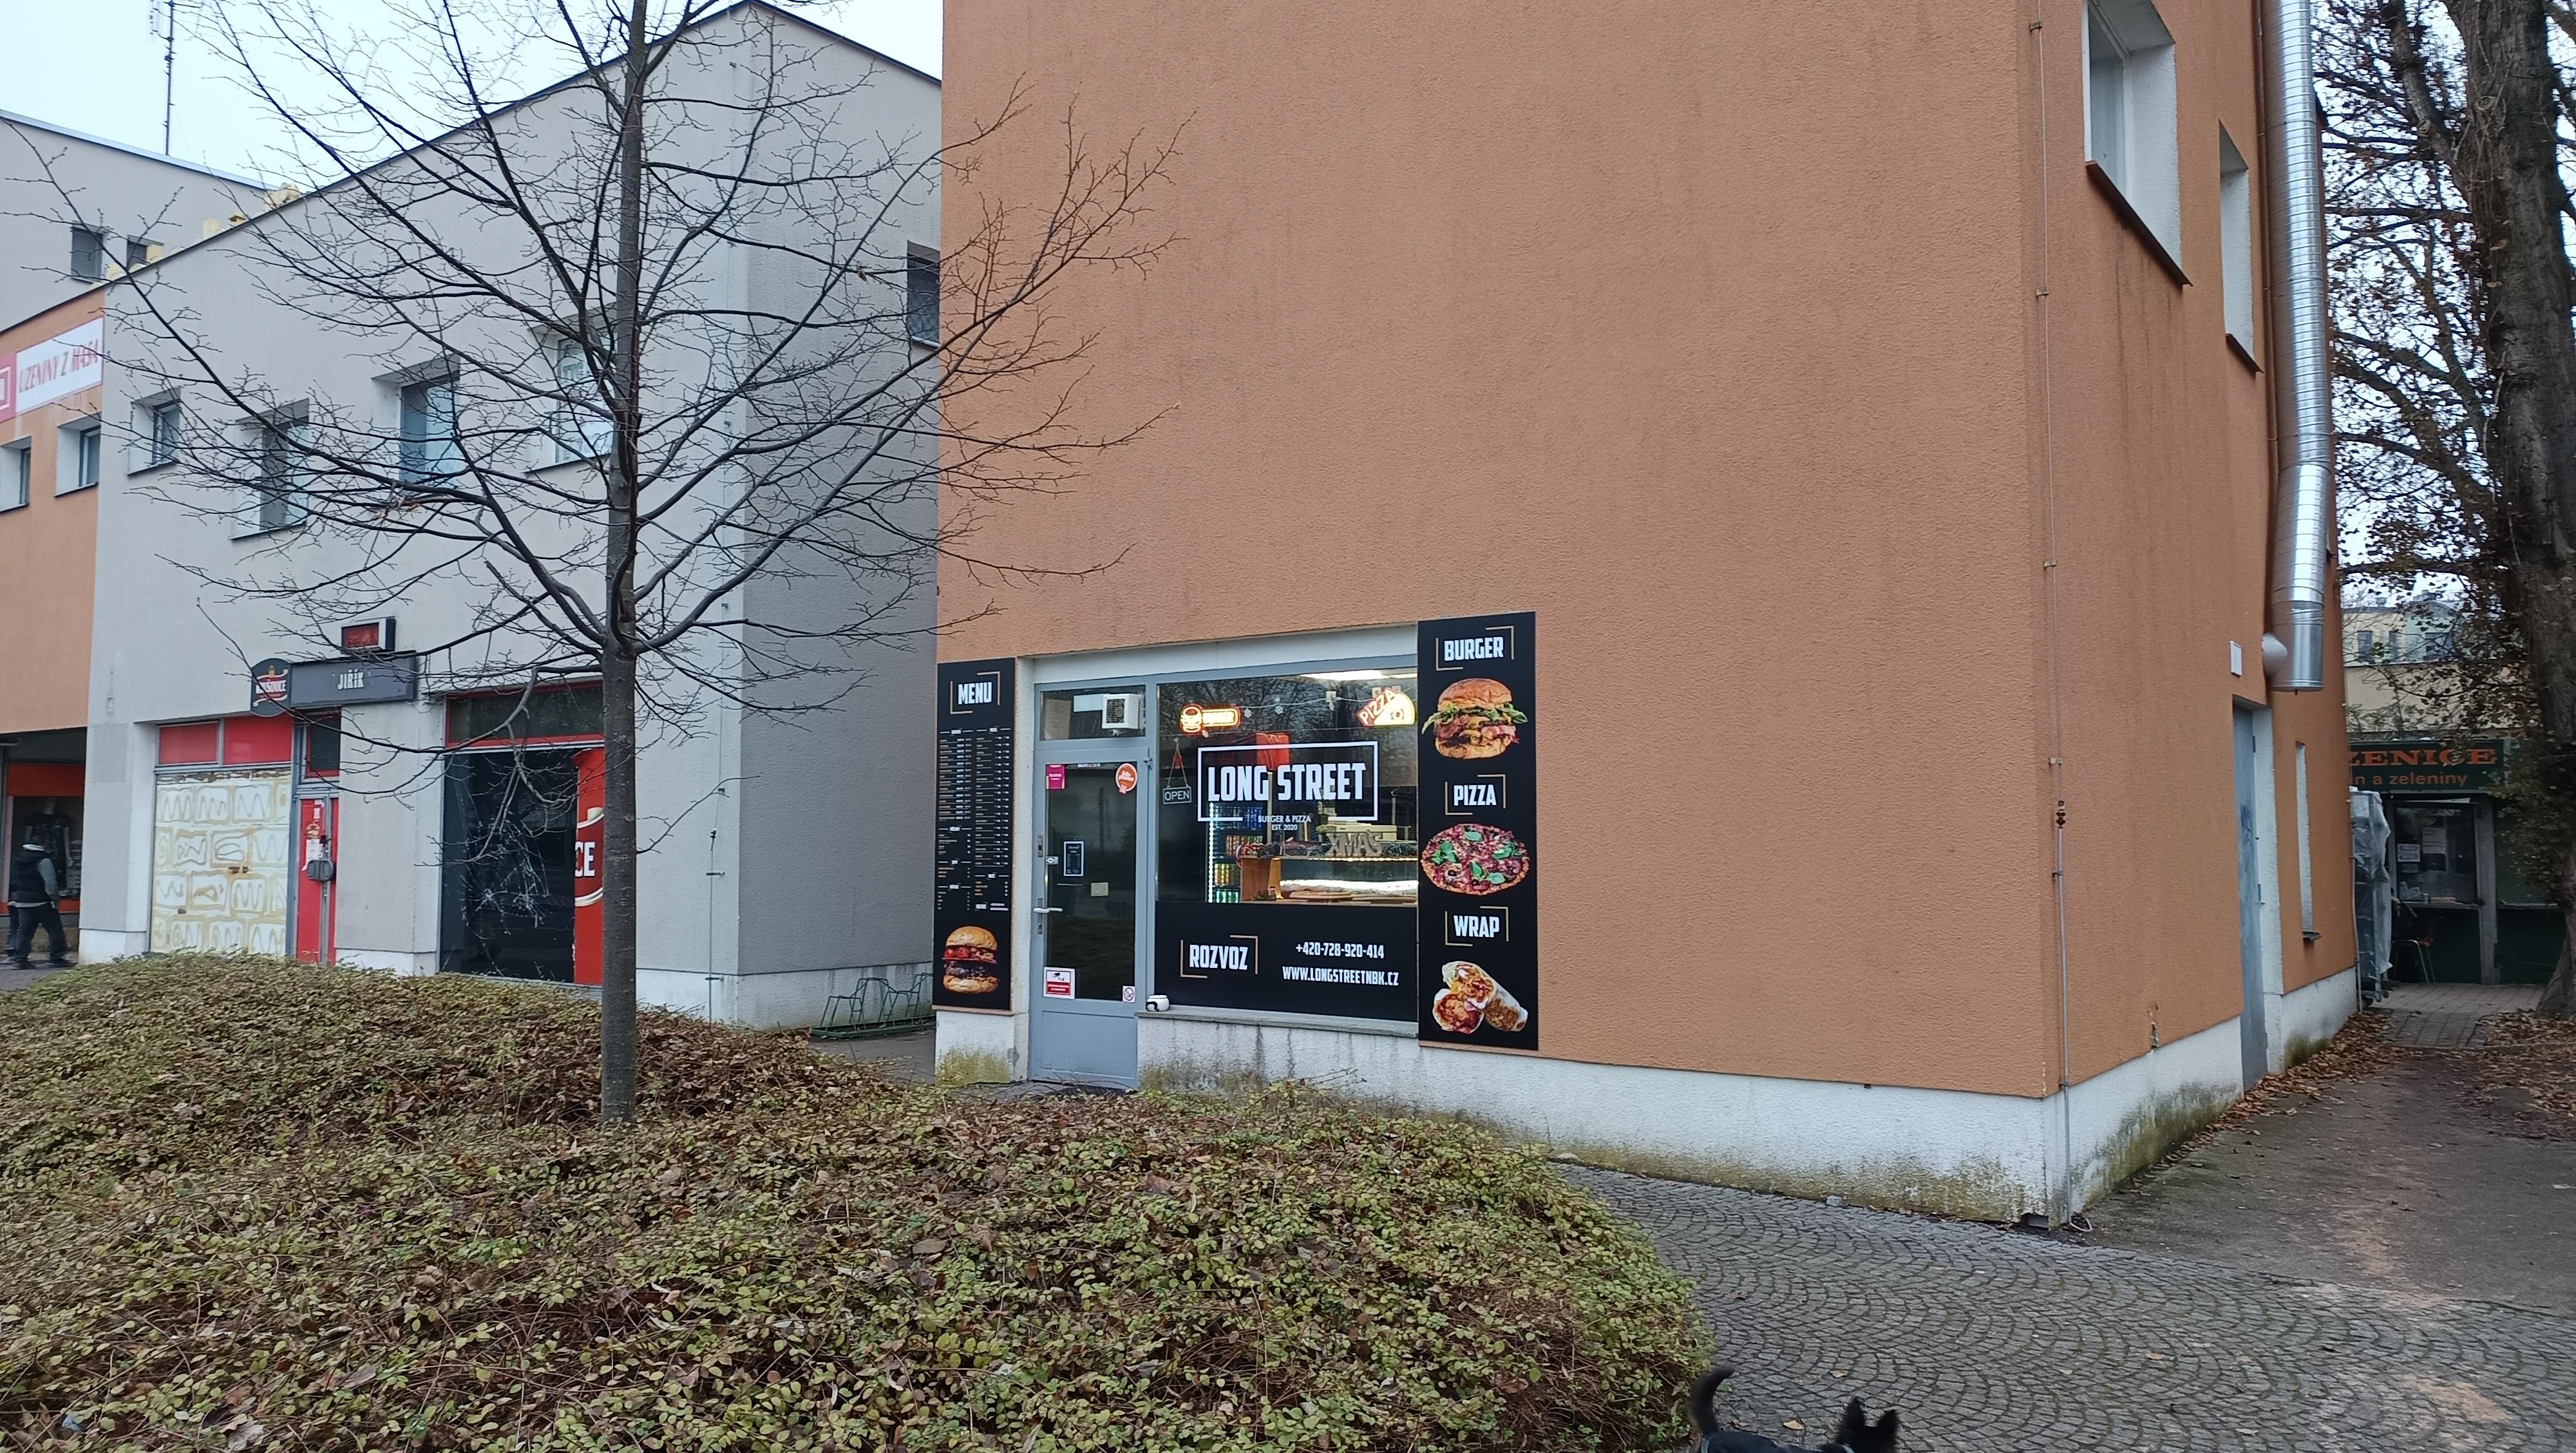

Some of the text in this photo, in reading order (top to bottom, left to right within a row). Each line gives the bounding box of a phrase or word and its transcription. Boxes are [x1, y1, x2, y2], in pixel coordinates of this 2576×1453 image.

[61, 350, 70, 377] Z
[1444, 636, 1504, 661] BURGER
[337, 668, 365, 690] JIŘÍK
[958, 681, 992, 705] MENU
[1358, 689, 1396, 726] PIZZA
[1208, 763, 1367, 802] LONG STREET
[2372, 775, 2383, 785] a
[2389, 772, 2468, 787] zeleniny
[1164, 789, 1190, 801] OPEN
[1453, 784, 1497, 806] PIZZA
[1258, 815, 1312, 823] BURGER & PIZZA
[1453, 915, 1500, 938] WRAP
[1189, 944, 1249, 971] ROZVOZ
[1295, 942, 1385, 959] +420-728-920-414
[1282, 965, 1399, 986] WWW.LONGSTREETNBK.CZ
